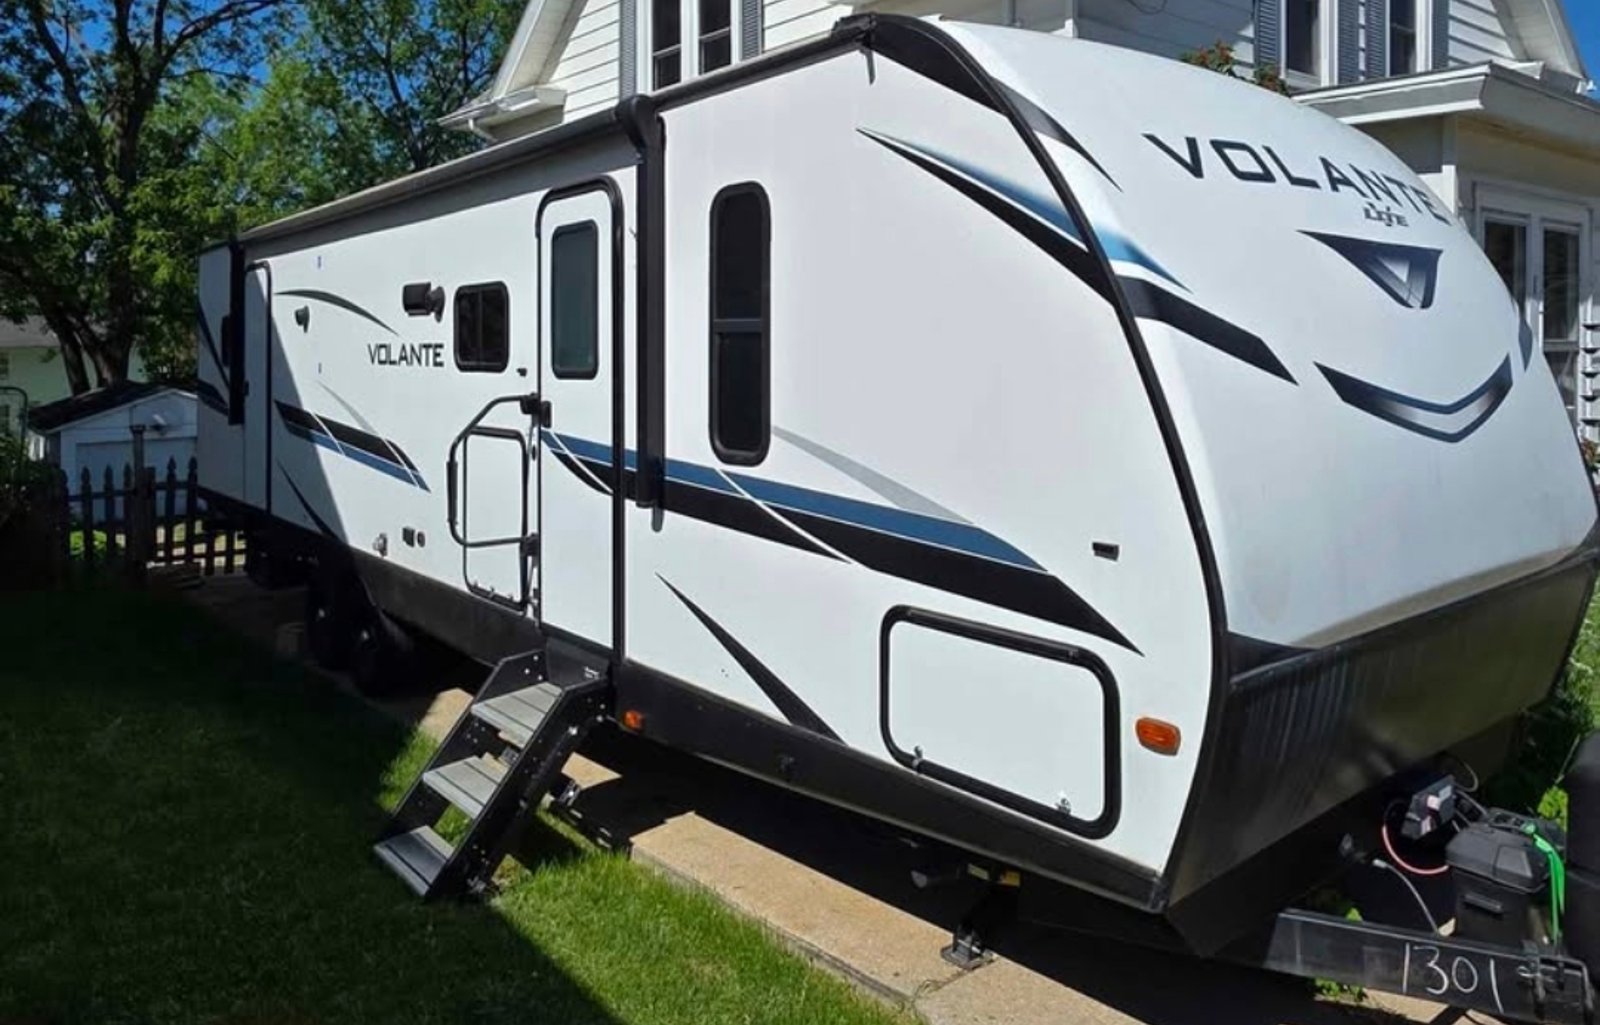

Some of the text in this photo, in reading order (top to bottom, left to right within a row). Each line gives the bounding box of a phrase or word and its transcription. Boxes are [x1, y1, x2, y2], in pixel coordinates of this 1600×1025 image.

[1141, 133, 1452, 226] VOLANTE
[367, 343, 445, 367] VOLANTE
[1402, 942, 1505, 1014] 1301
